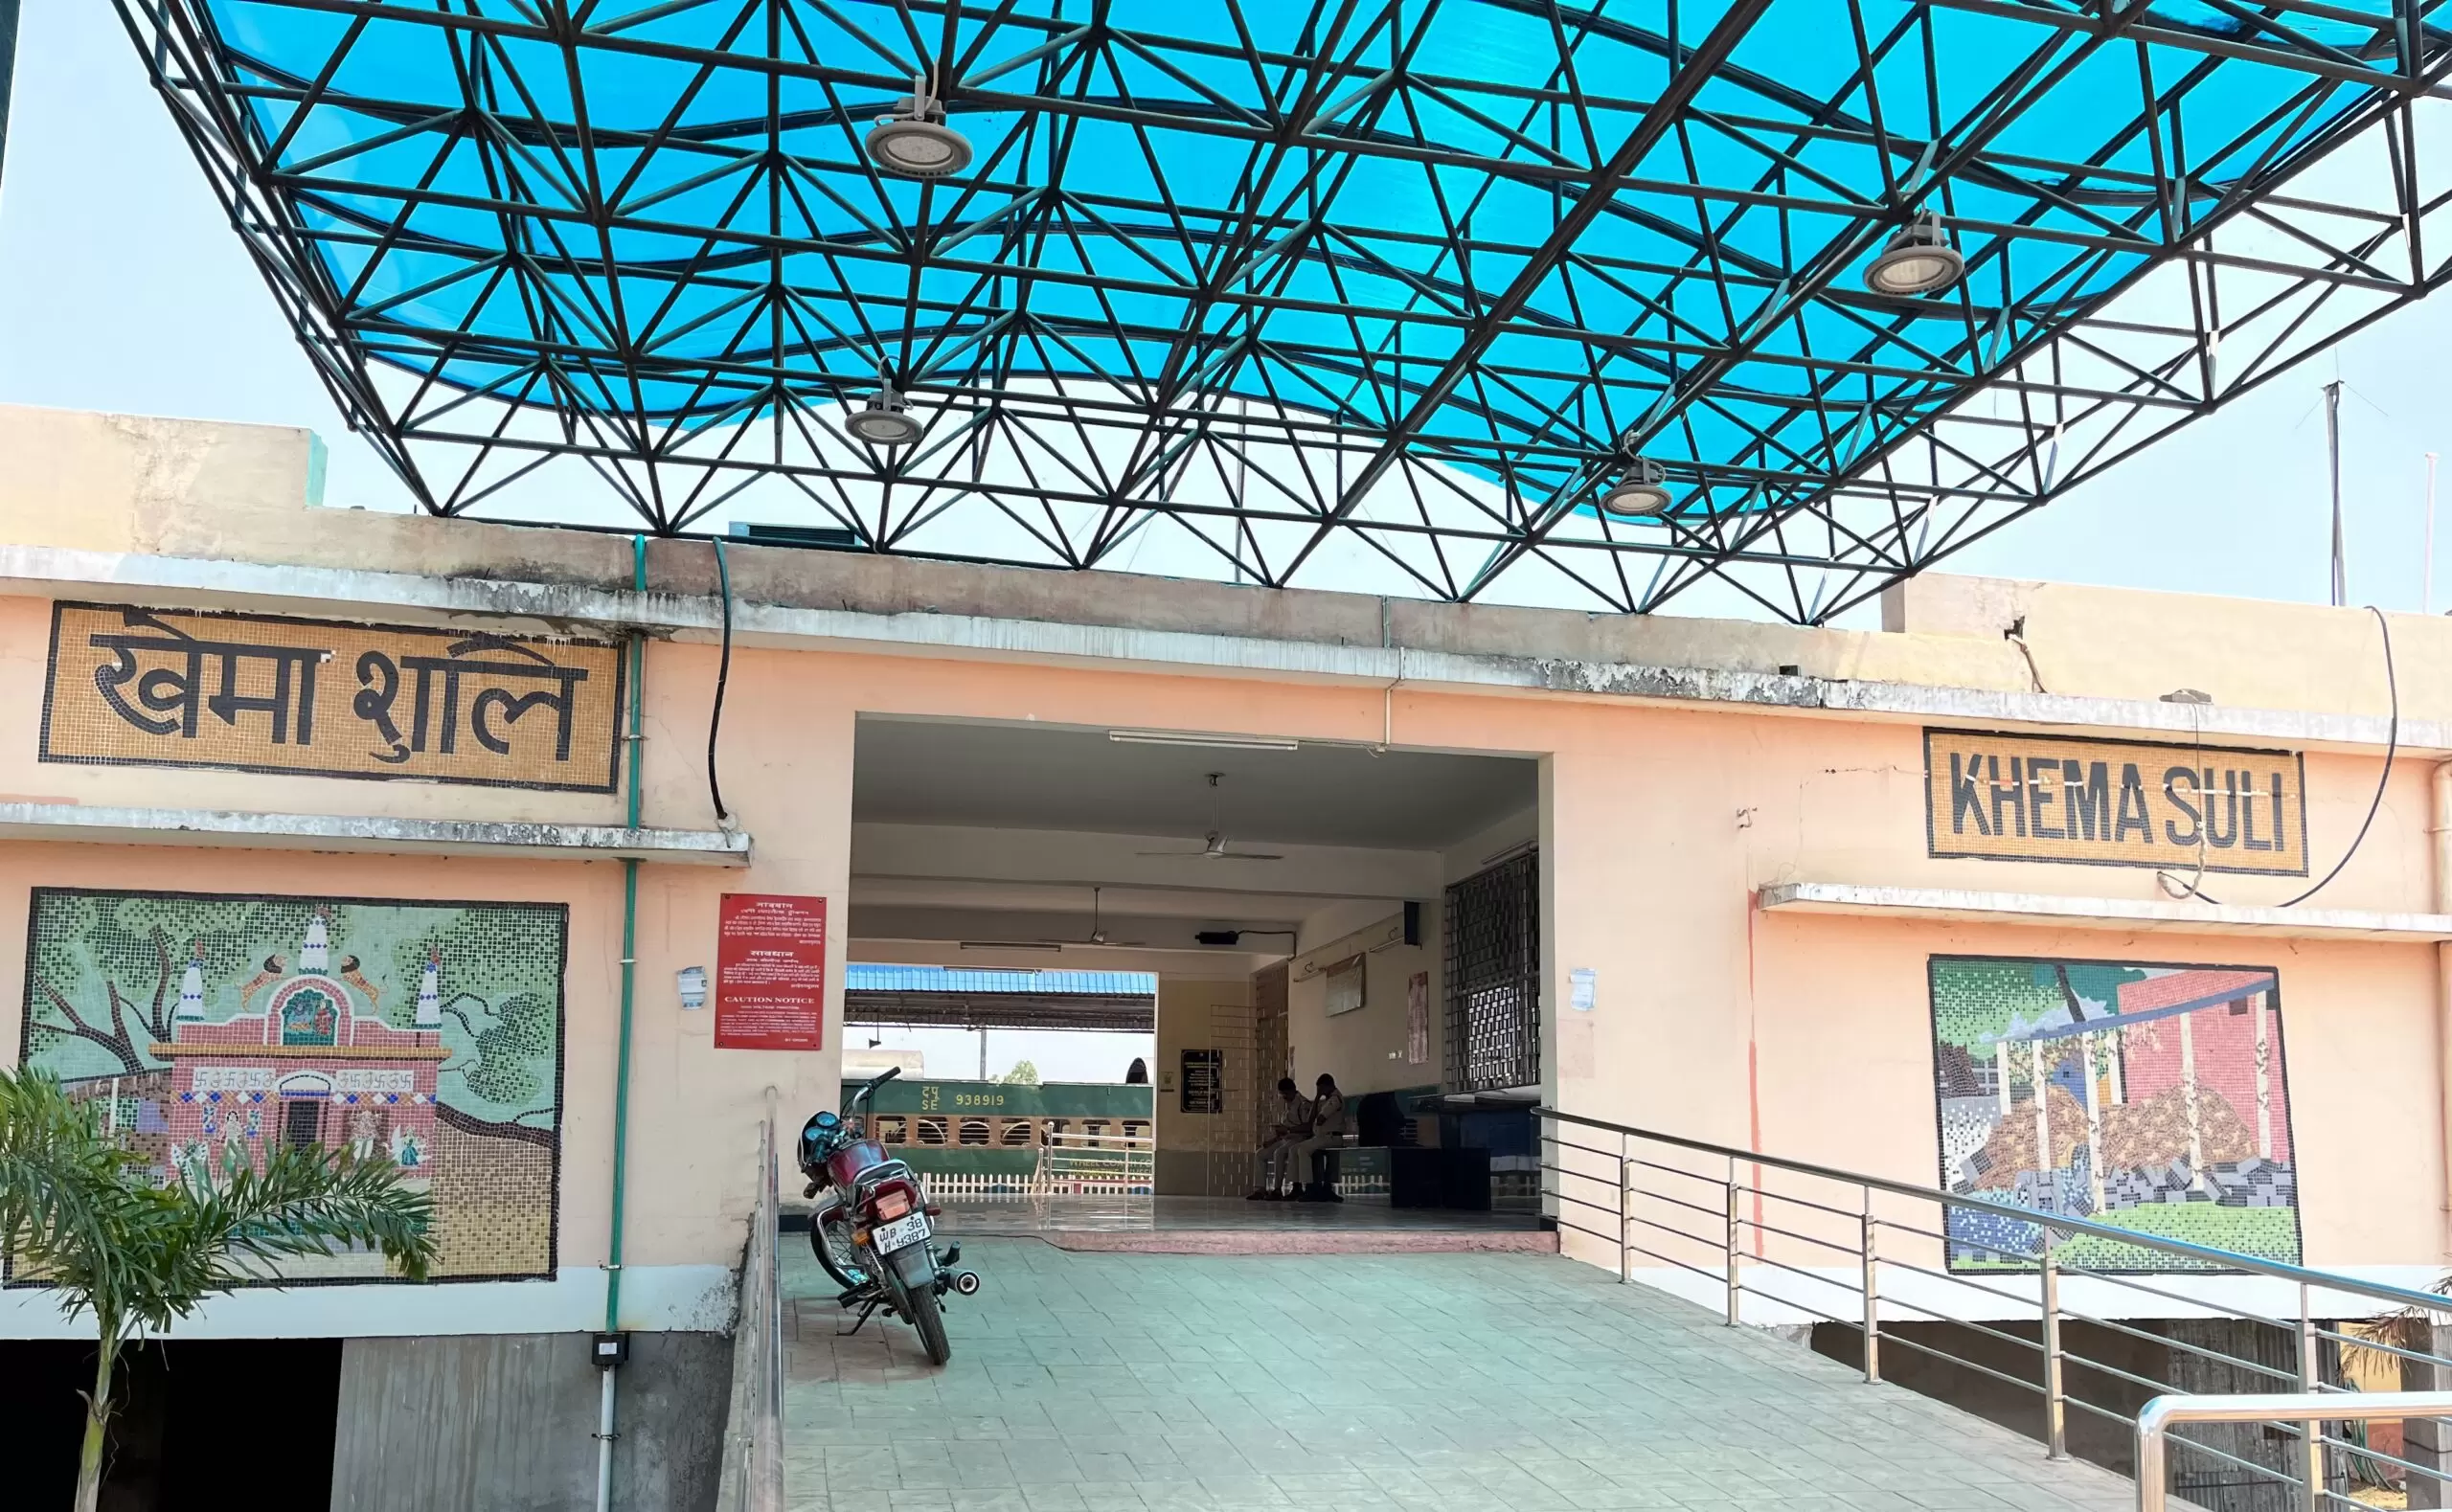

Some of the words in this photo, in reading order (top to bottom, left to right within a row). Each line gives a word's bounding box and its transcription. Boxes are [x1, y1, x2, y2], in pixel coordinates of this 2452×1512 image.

[1949, 752, 2154, 845] KHEMA
[2162, 765, 2285, 852] SULI
[921, 1099, 938, 1111] SE
[956, 1094, 1004, 1106] 938919
[879, 1228, 897, 1243] WB
